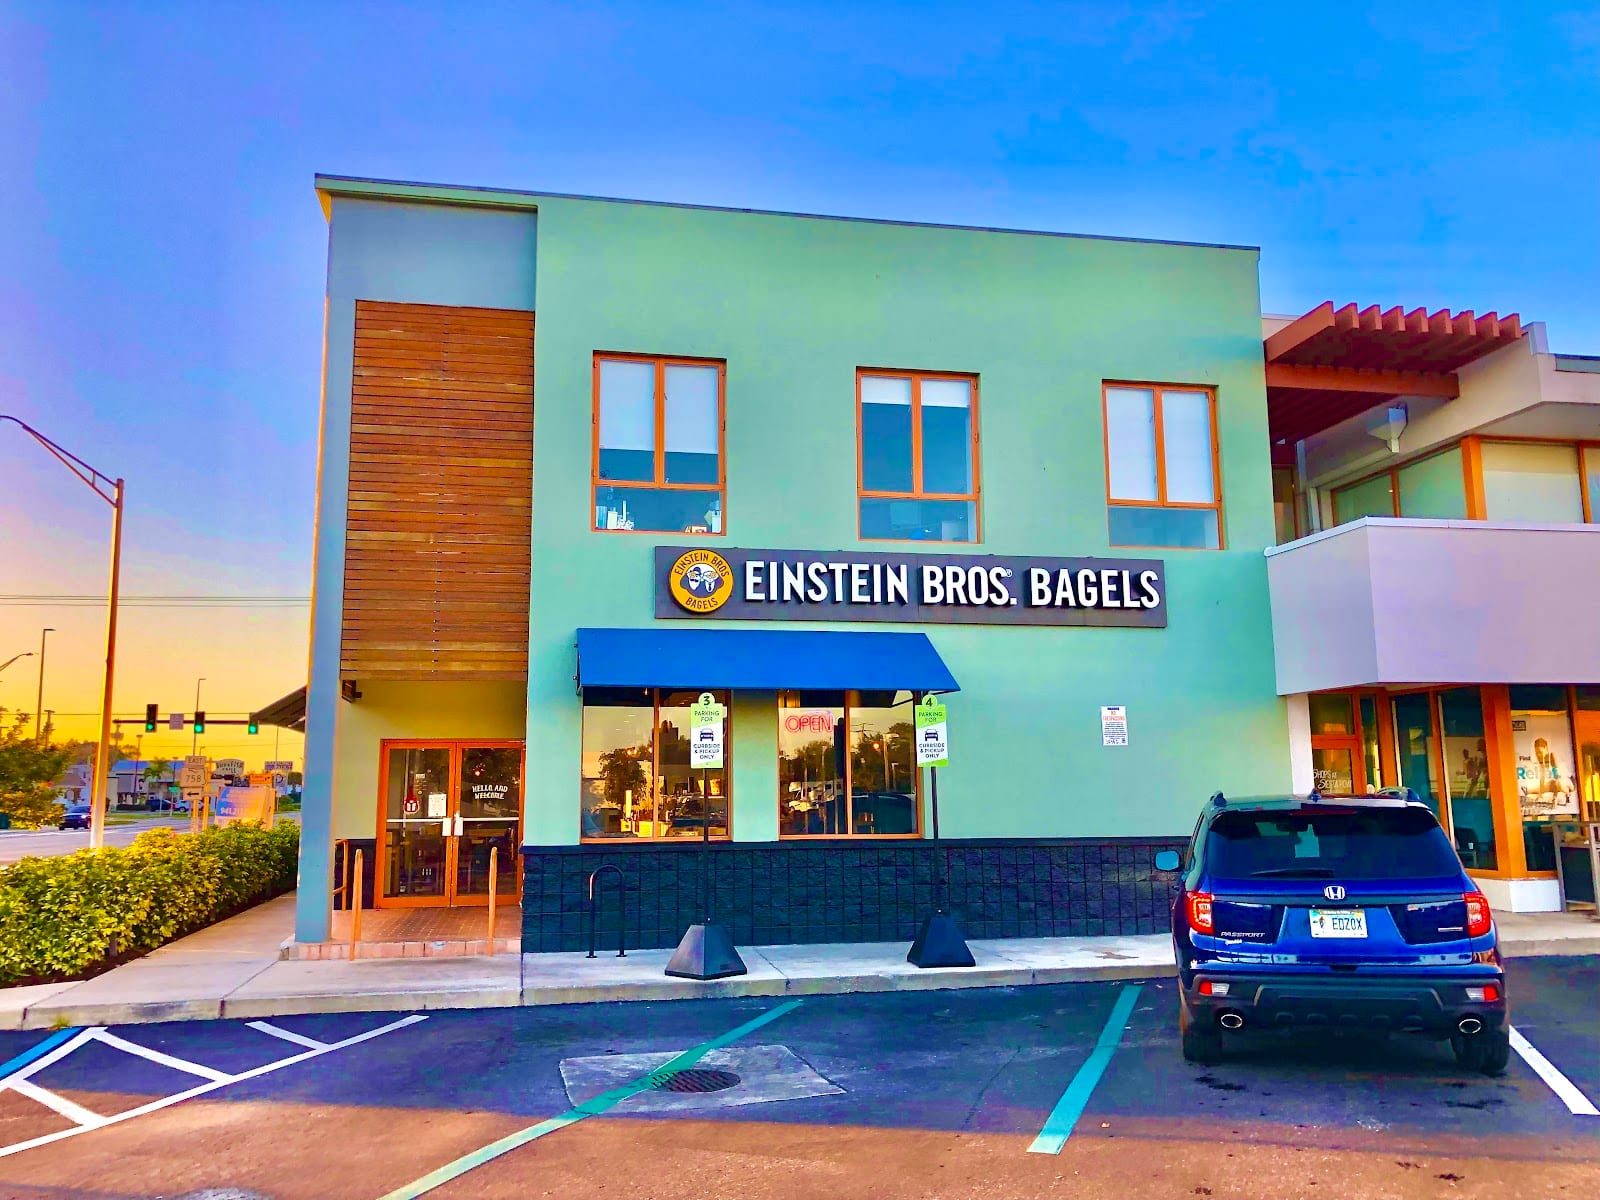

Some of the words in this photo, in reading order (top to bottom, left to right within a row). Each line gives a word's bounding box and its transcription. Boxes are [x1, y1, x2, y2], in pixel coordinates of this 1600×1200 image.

[674, 552, 709, 576] EINSTEIN
[711, 556, 730, 577] BROS
[745, 560, 909, 604] EINSTEIN
[1030, 567, 1160, 609] BAGELS
[685, 597, 719, 610] BAGELS
[704, 696, 710, 706] 3
[926, 698, 933, 707] 4
[785, 714, 833, 733] OPEN
[186, 774, 202, 783] 758
[474, 791, 505, 800] WELCOME
